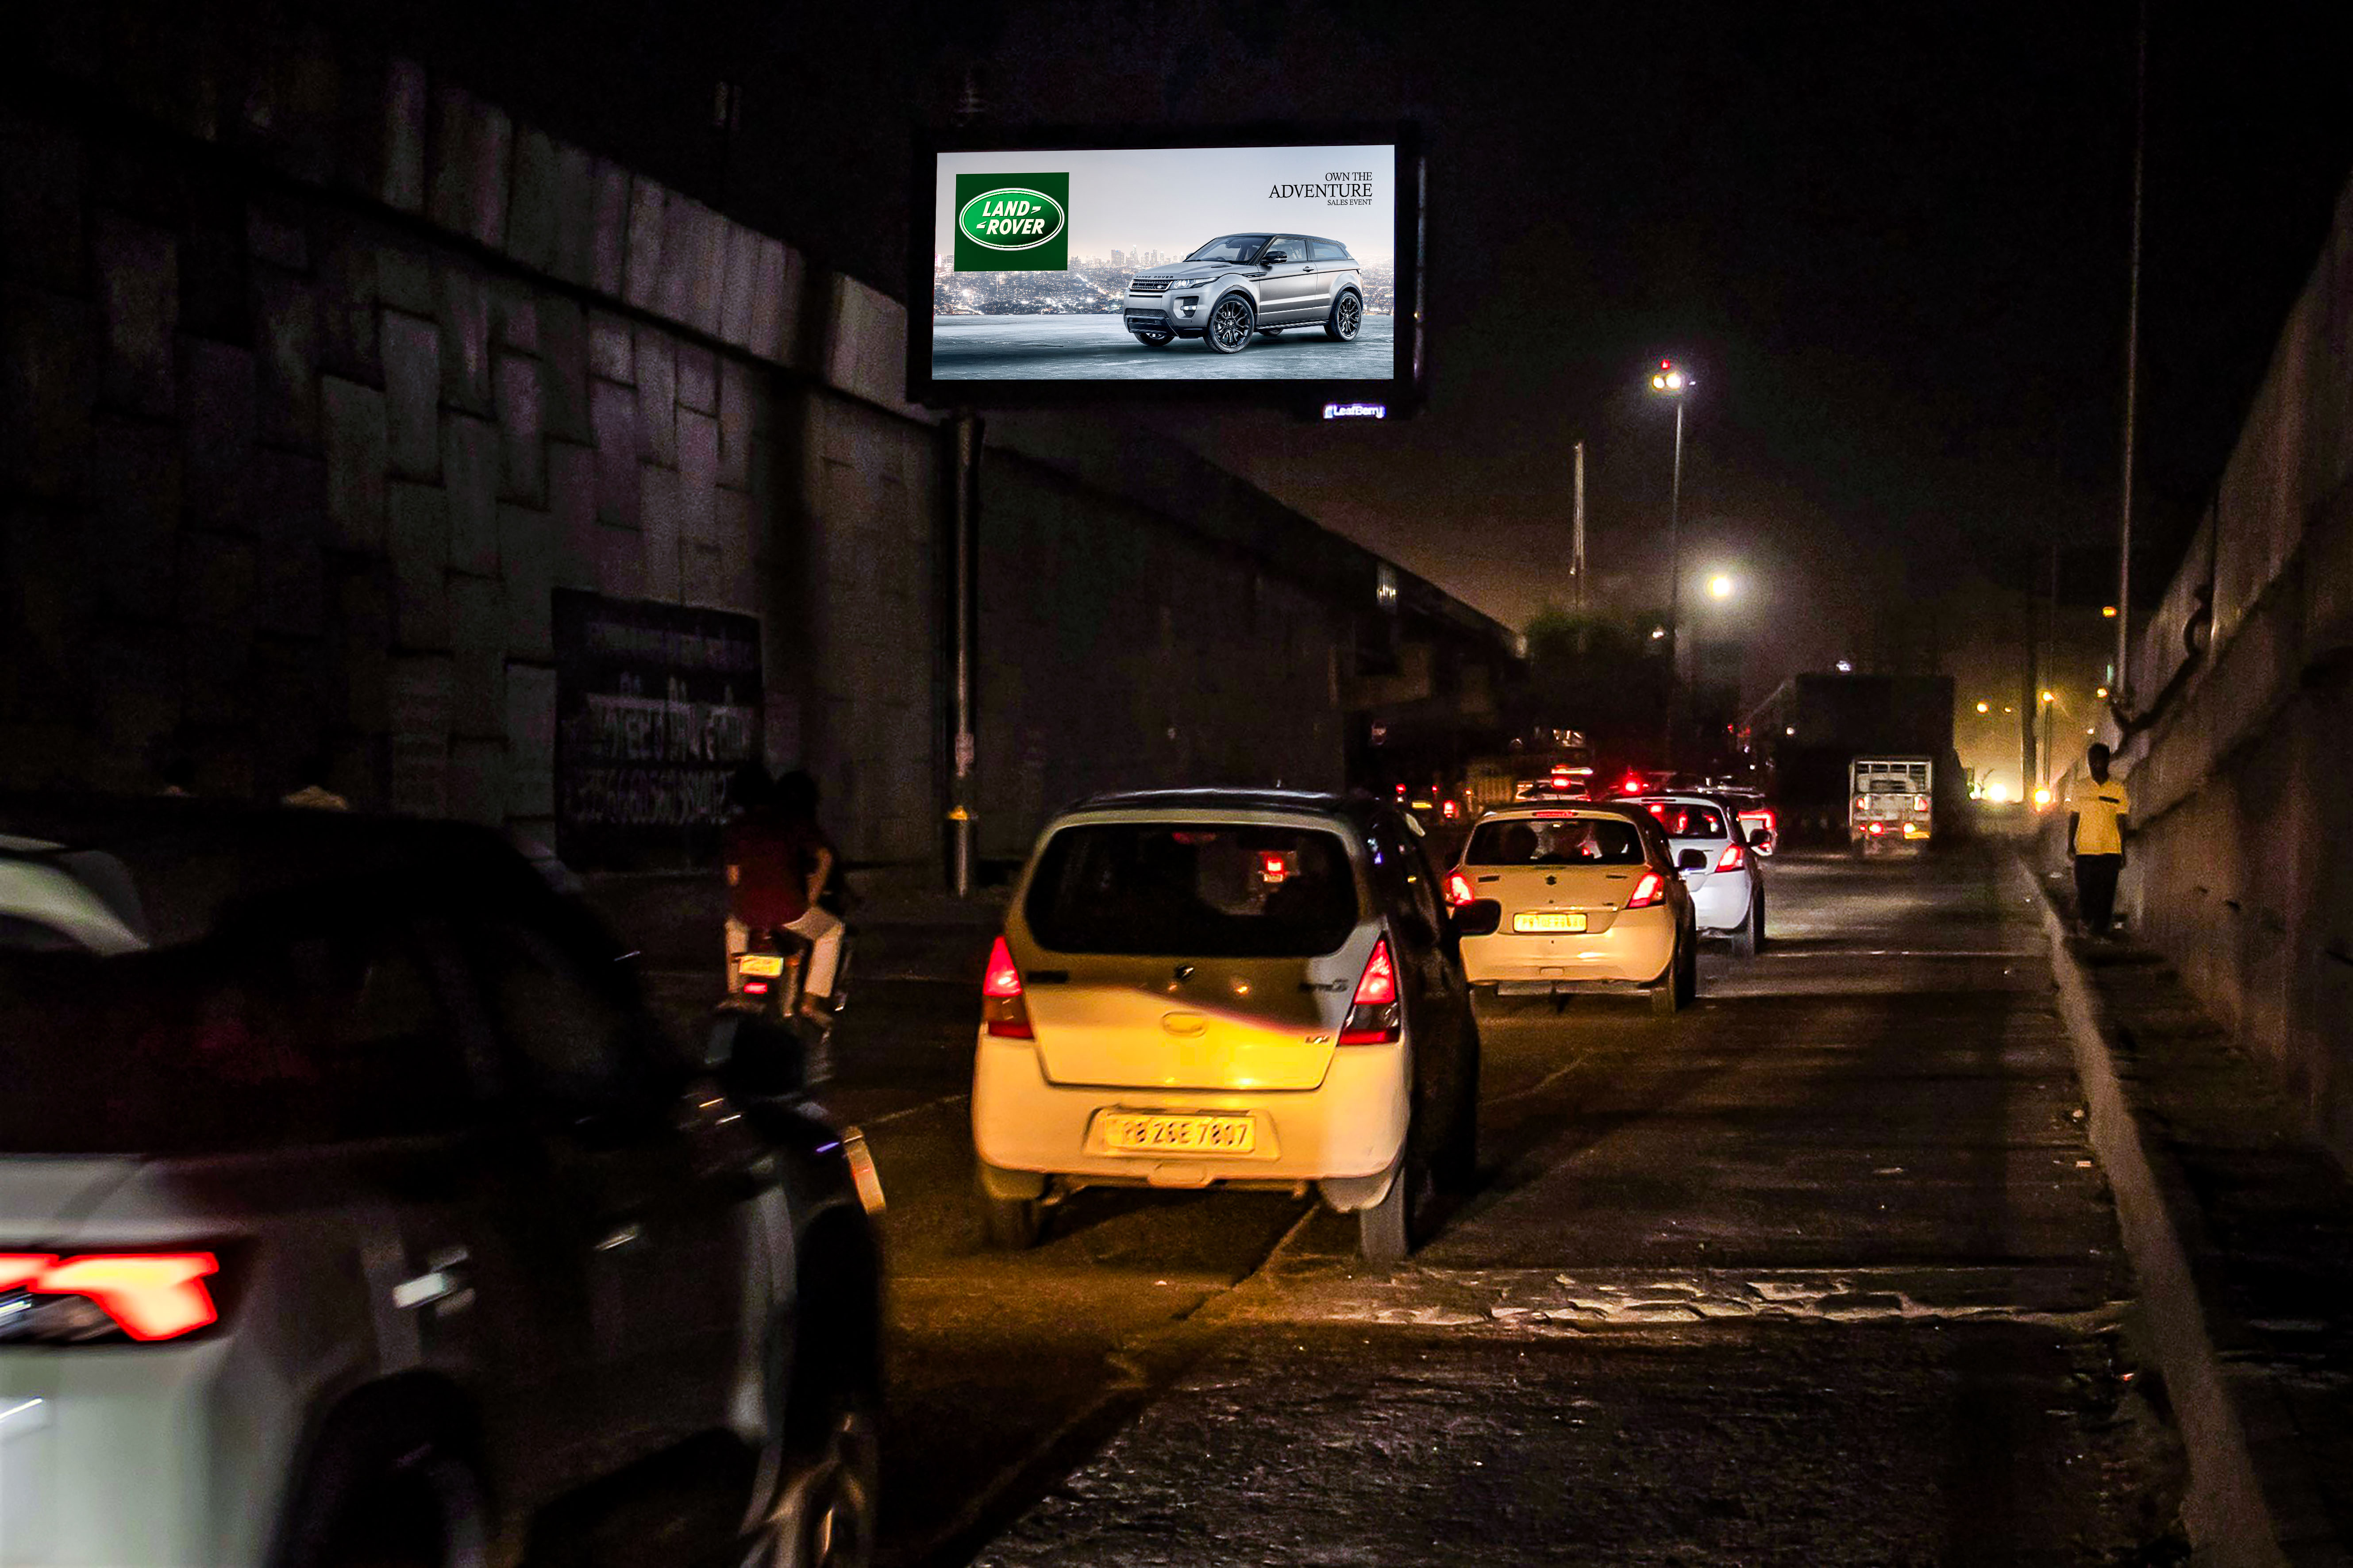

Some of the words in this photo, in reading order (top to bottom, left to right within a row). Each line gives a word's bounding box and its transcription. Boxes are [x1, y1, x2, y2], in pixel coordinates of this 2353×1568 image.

[1325, 172, 1350, 181] OWN
[1352, 172, 1373, 181] THE
[1268, 183, 1373, 198] ADVENTURE
